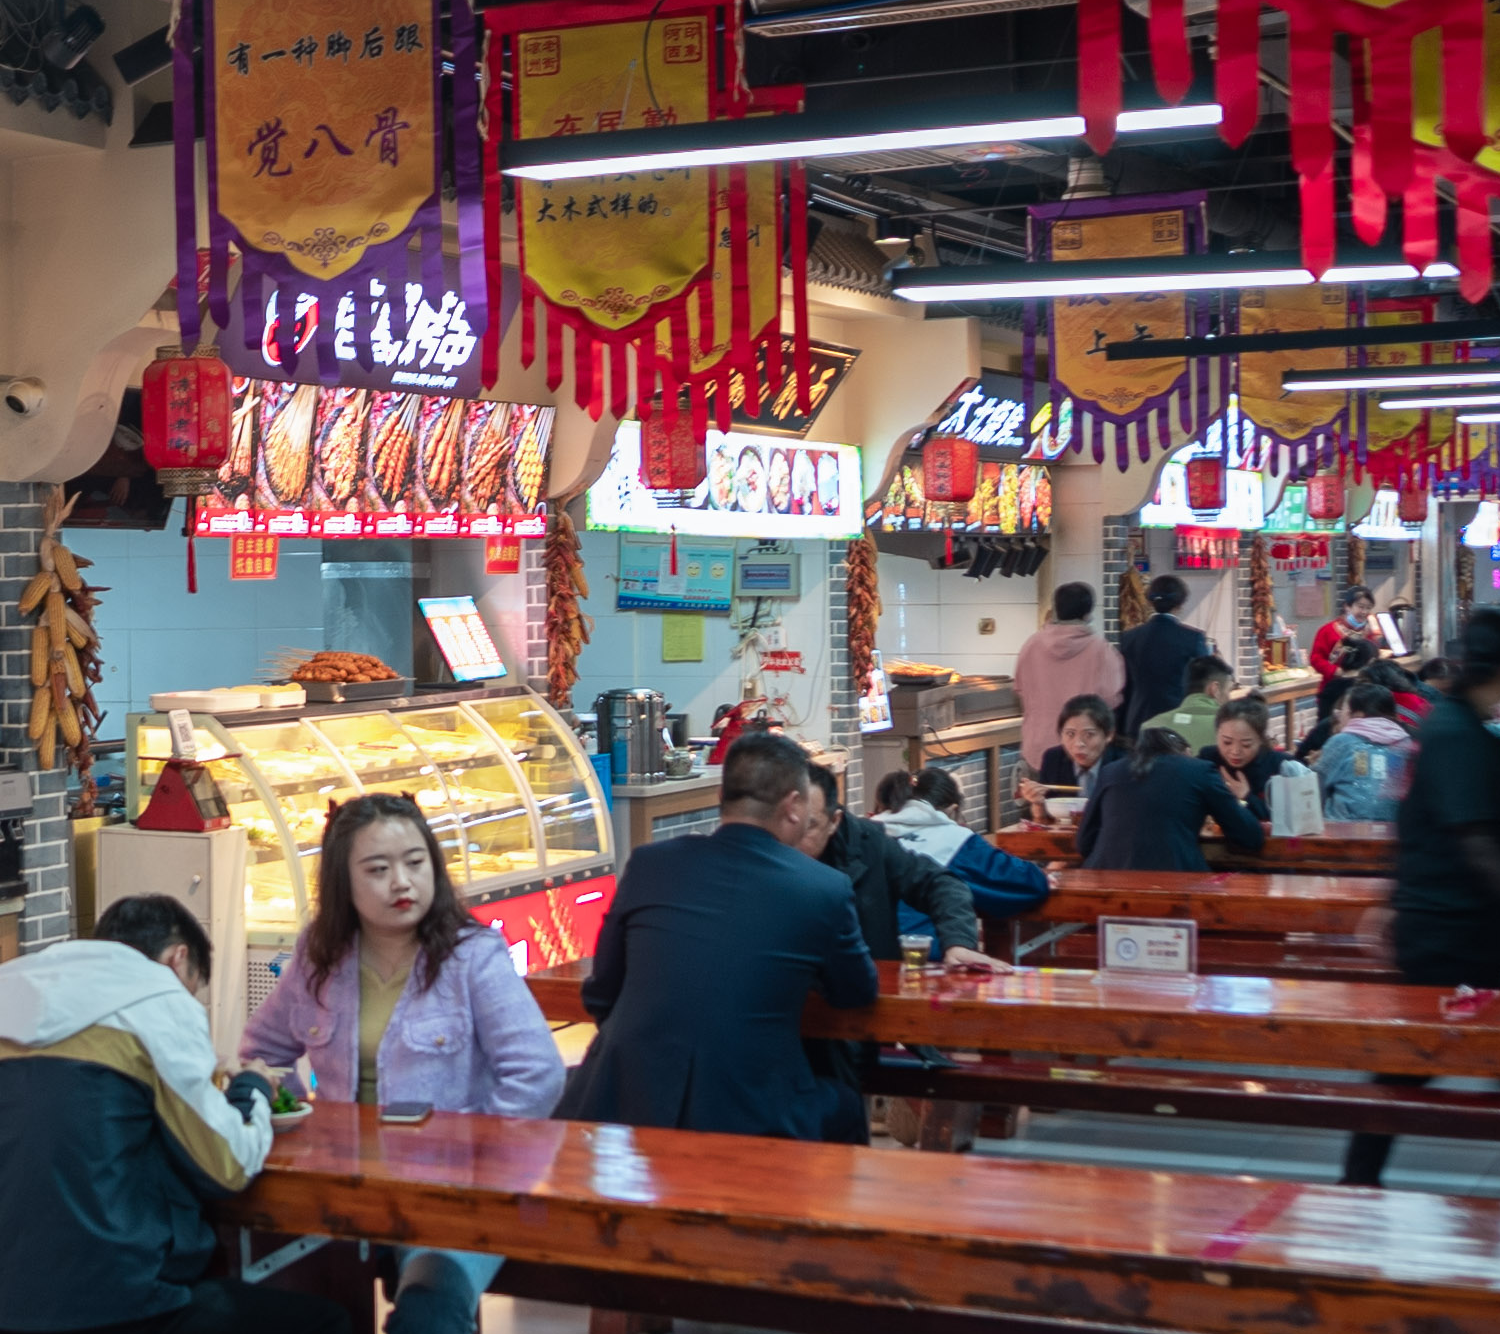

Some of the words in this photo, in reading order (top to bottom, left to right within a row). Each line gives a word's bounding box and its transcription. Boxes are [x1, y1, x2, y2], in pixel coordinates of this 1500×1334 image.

[227, 23, 424, 77] 有一种脚后跟
[247, 106, 411, 179] 觉八骨
